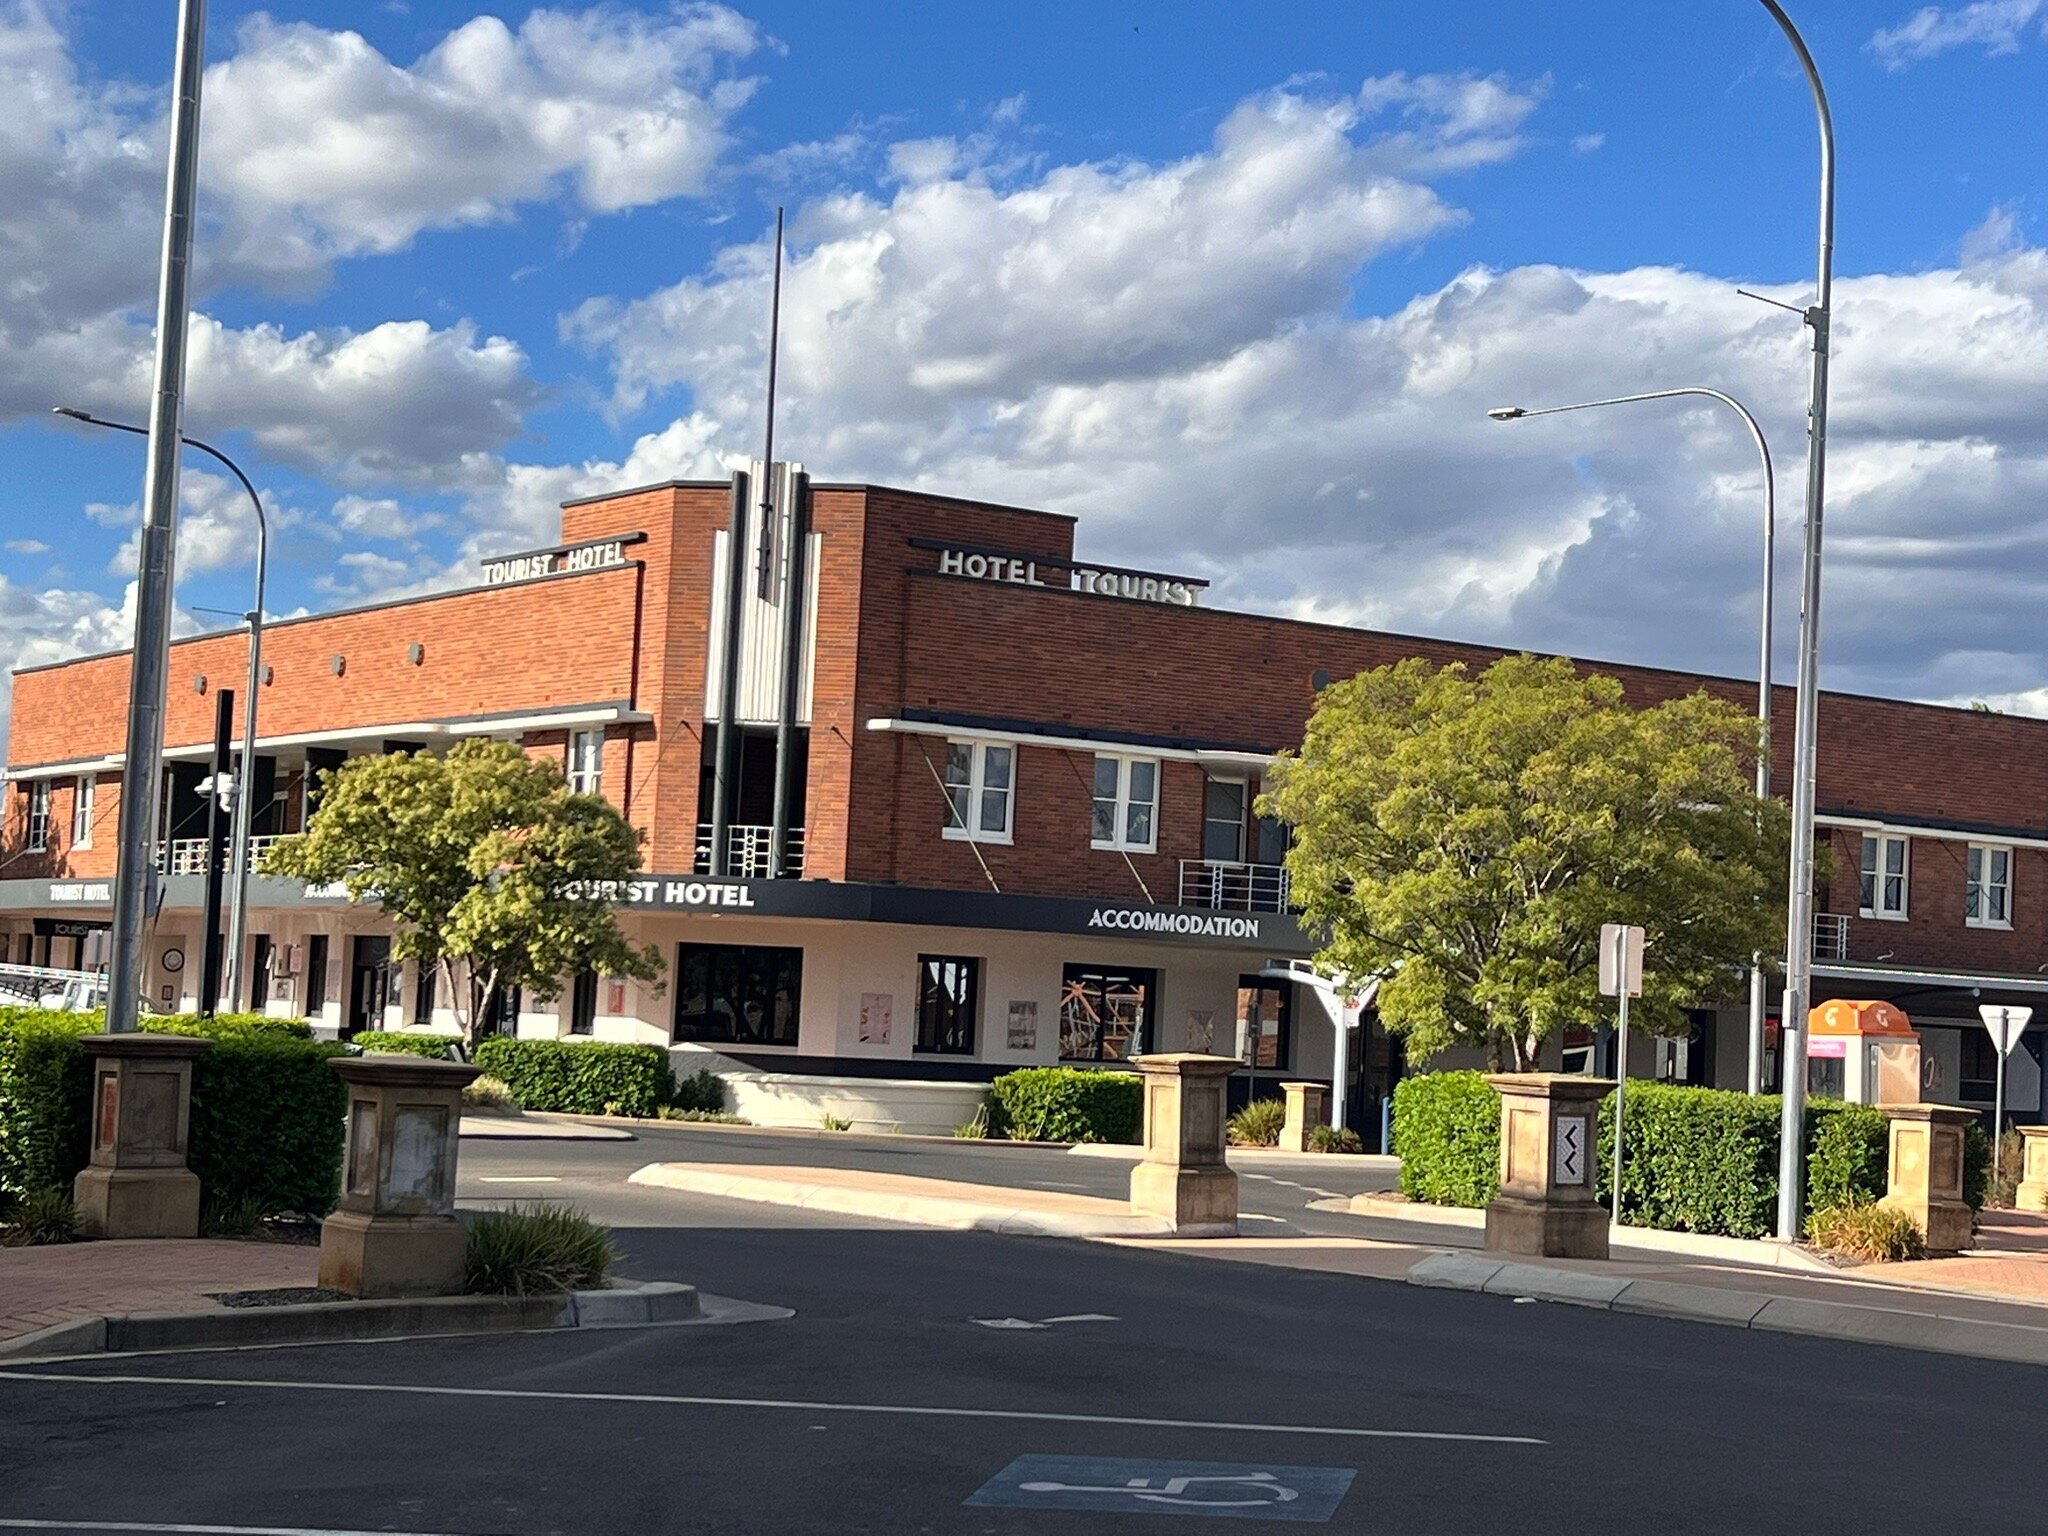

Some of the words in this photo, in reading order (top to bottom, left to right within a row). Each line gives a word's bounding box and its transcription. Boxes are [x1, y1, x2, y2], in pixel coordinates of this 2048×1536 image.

[482, 554, 553, 585] TOURIST
[568, 541, 625, 571] HOTEL
[939, 549, 1045, 586] HOTEL
[1078, 569, 1205, 607] TOURIST
[84, 884, 111, 901] HOTEL
[664, 881, 755, 907] HOTEL
[1088, 908, 1261, 939] ACCOMMODATION
